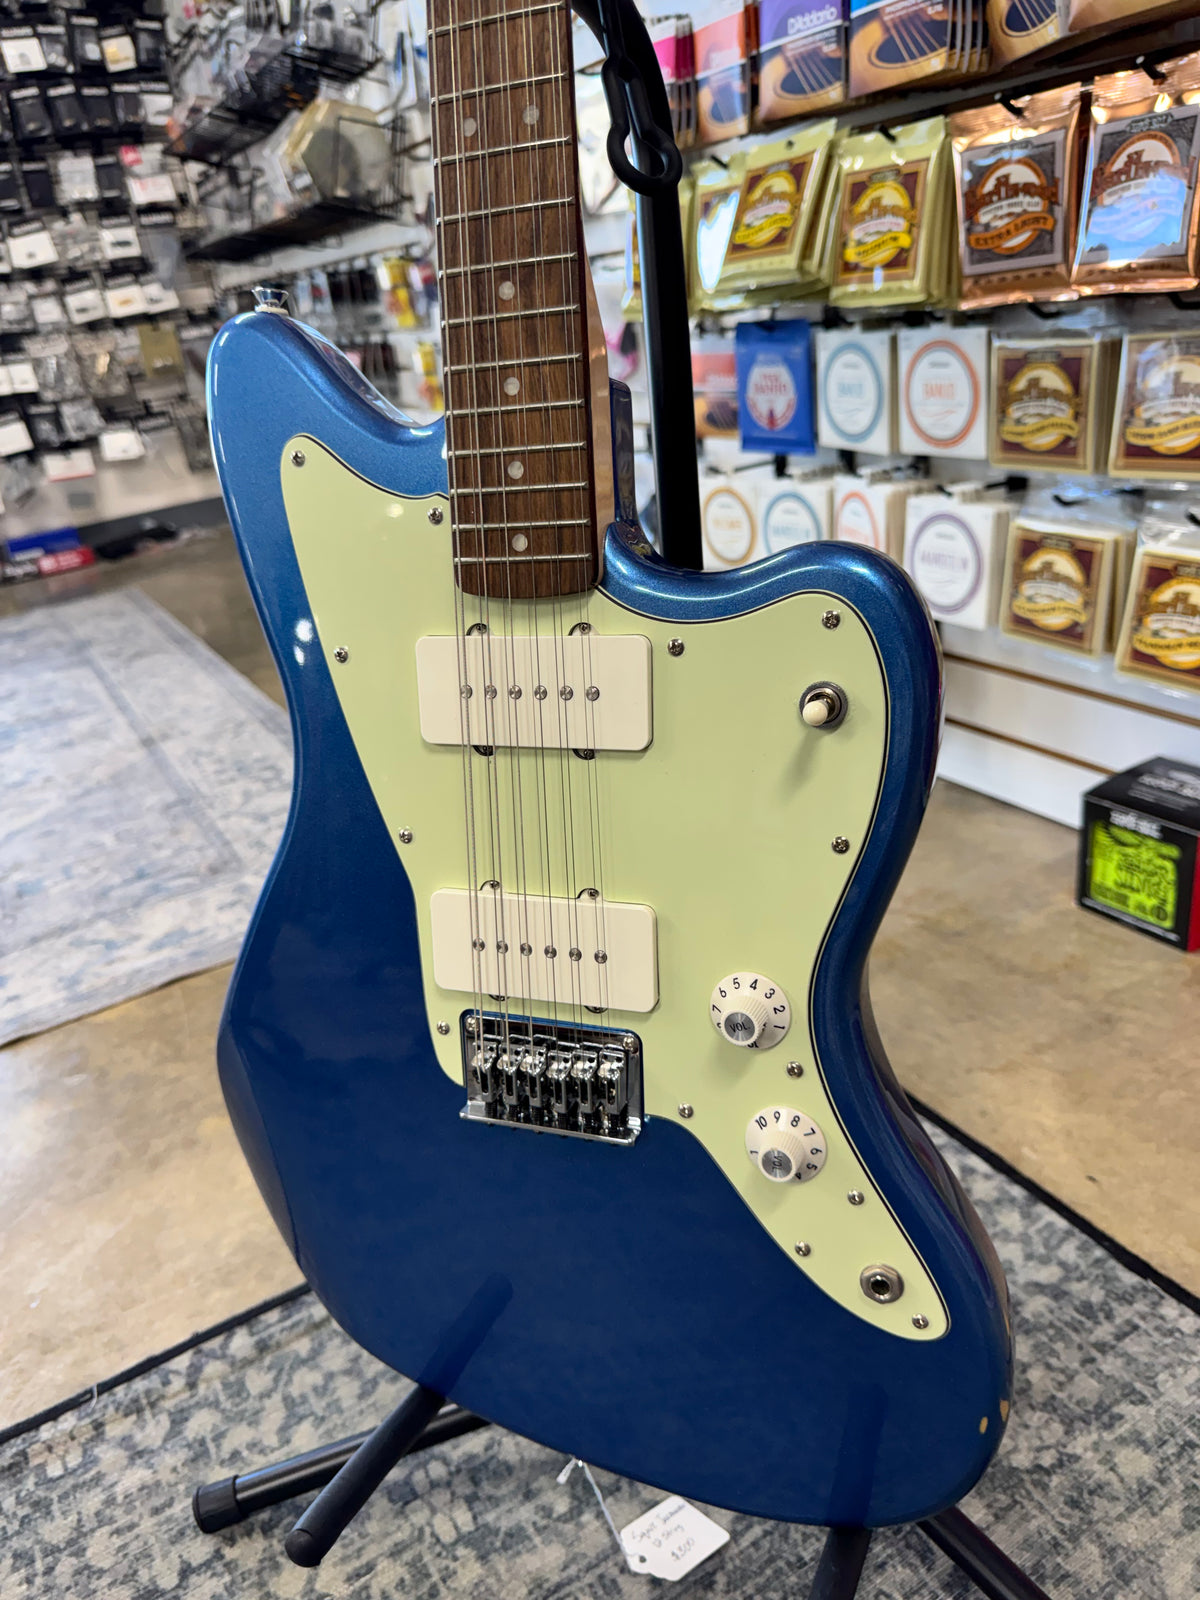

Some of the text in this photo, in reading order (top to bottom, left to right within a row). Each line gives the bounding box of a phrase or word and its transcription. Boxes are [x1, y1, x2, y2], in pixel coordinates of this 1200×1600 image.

[719, 987, 727, 998] 6
[732, 977, 741, 990] 5
[749, 978, 759, 991] 4
[764, 988, 776, 1000] 3
[773, 1005, 786, 1015] 2
[755, 1115, 768, 1131] 10
[773, 1110, 781, 1124] 9
[790, 1115, 801, 1128] 8
[803, 1127, 816, 1137] 7
[806, 1162, 818, 1171] 5
